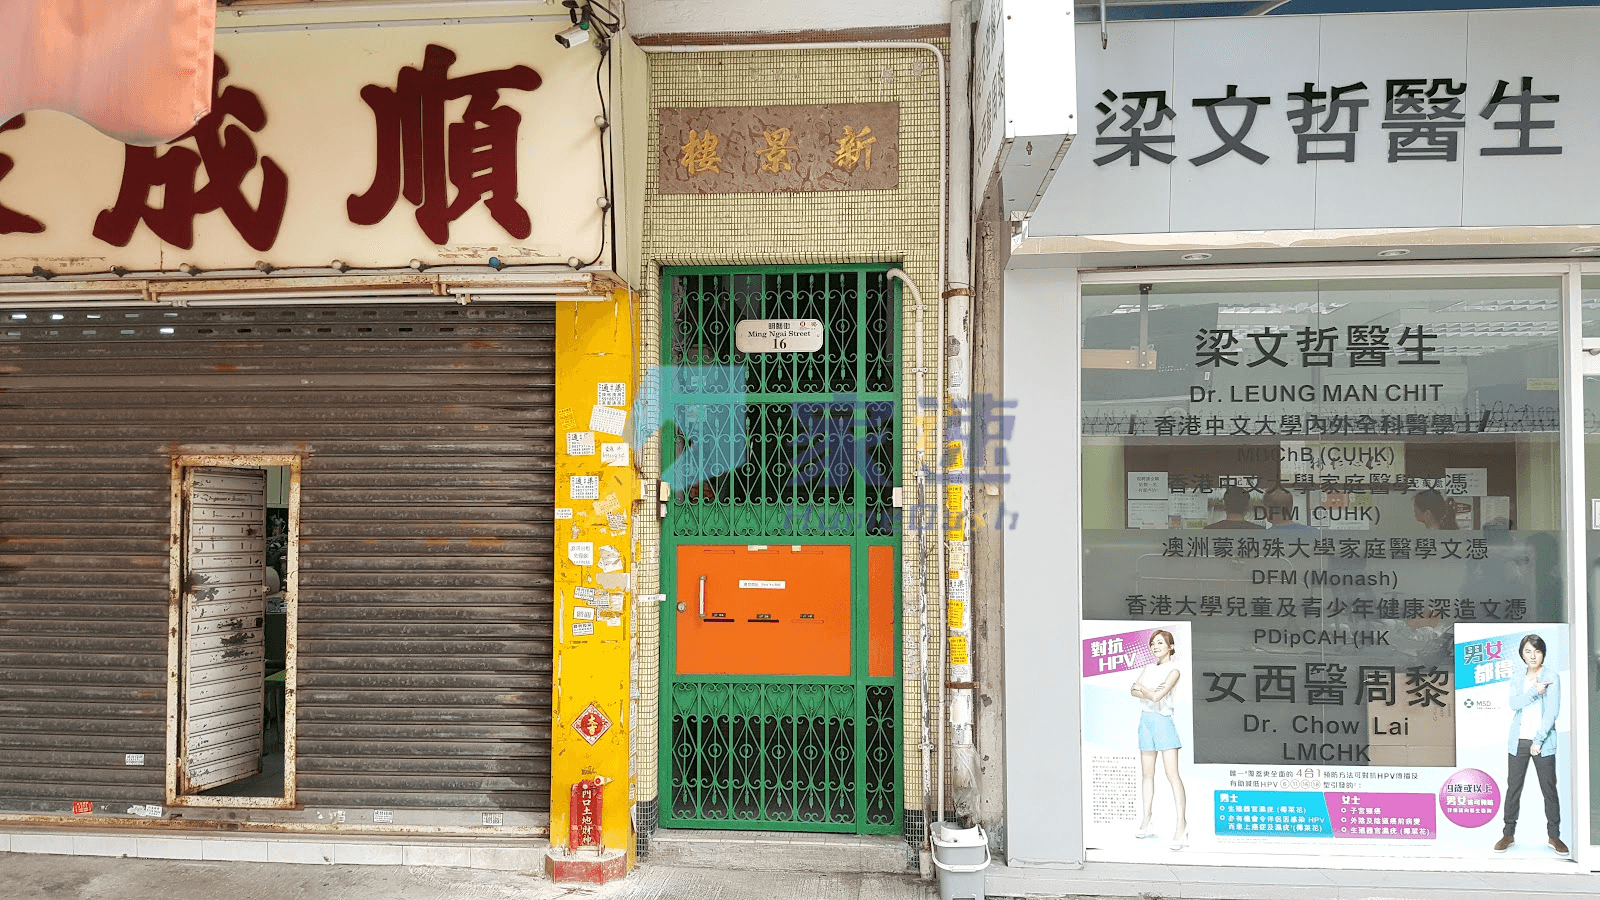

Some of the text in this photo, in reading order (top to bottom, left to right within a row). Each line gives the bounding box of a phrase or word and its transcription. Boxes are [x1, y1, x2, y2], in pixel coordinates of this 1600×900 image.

[1093, 76, 1563, 167] 梁文哲醫生
[680, 125, 878, 175] 新景樓
[773, 338, 787, 349] 16
[1195, 325, 1440, 368] 梁文哲醫生
[1190, 383, 1444, 403] Dr. LEUNG MAN CHIT
[1154, 414, 1483, 436] 香港中文大學內外全科醫學士
[1320, 446, 1395, 465] (CUHK)
[1168, 474, 1468, 495] 香港中文大學家庭醫學文憑
[1254, 506, 1299, 521] DFM
[1162, 537, 1489, 560] 澳洲蒙納殊大學家庭醫學文憑
[1252, 568, 1399, 588] DFM (Monash)
[1125, 595, 1528, 621] 香港大學兒童及青少年健康深造文憑
[1090, 638, 1124, 657] 對抗
[1254, 629, 1390, 649] PDipCAH (HK
[1099, 652, 1137, 672] HPV
[1464, 640, 1502, 666] 男女
[1474, 660, 1513, 684] 都得
[1202, 662, 1450, 708] 女西醫周黎
[1243, 714, 1409, 735] Dr. Chow Lai
[1283, 743, 1371, 762] LMCHK
